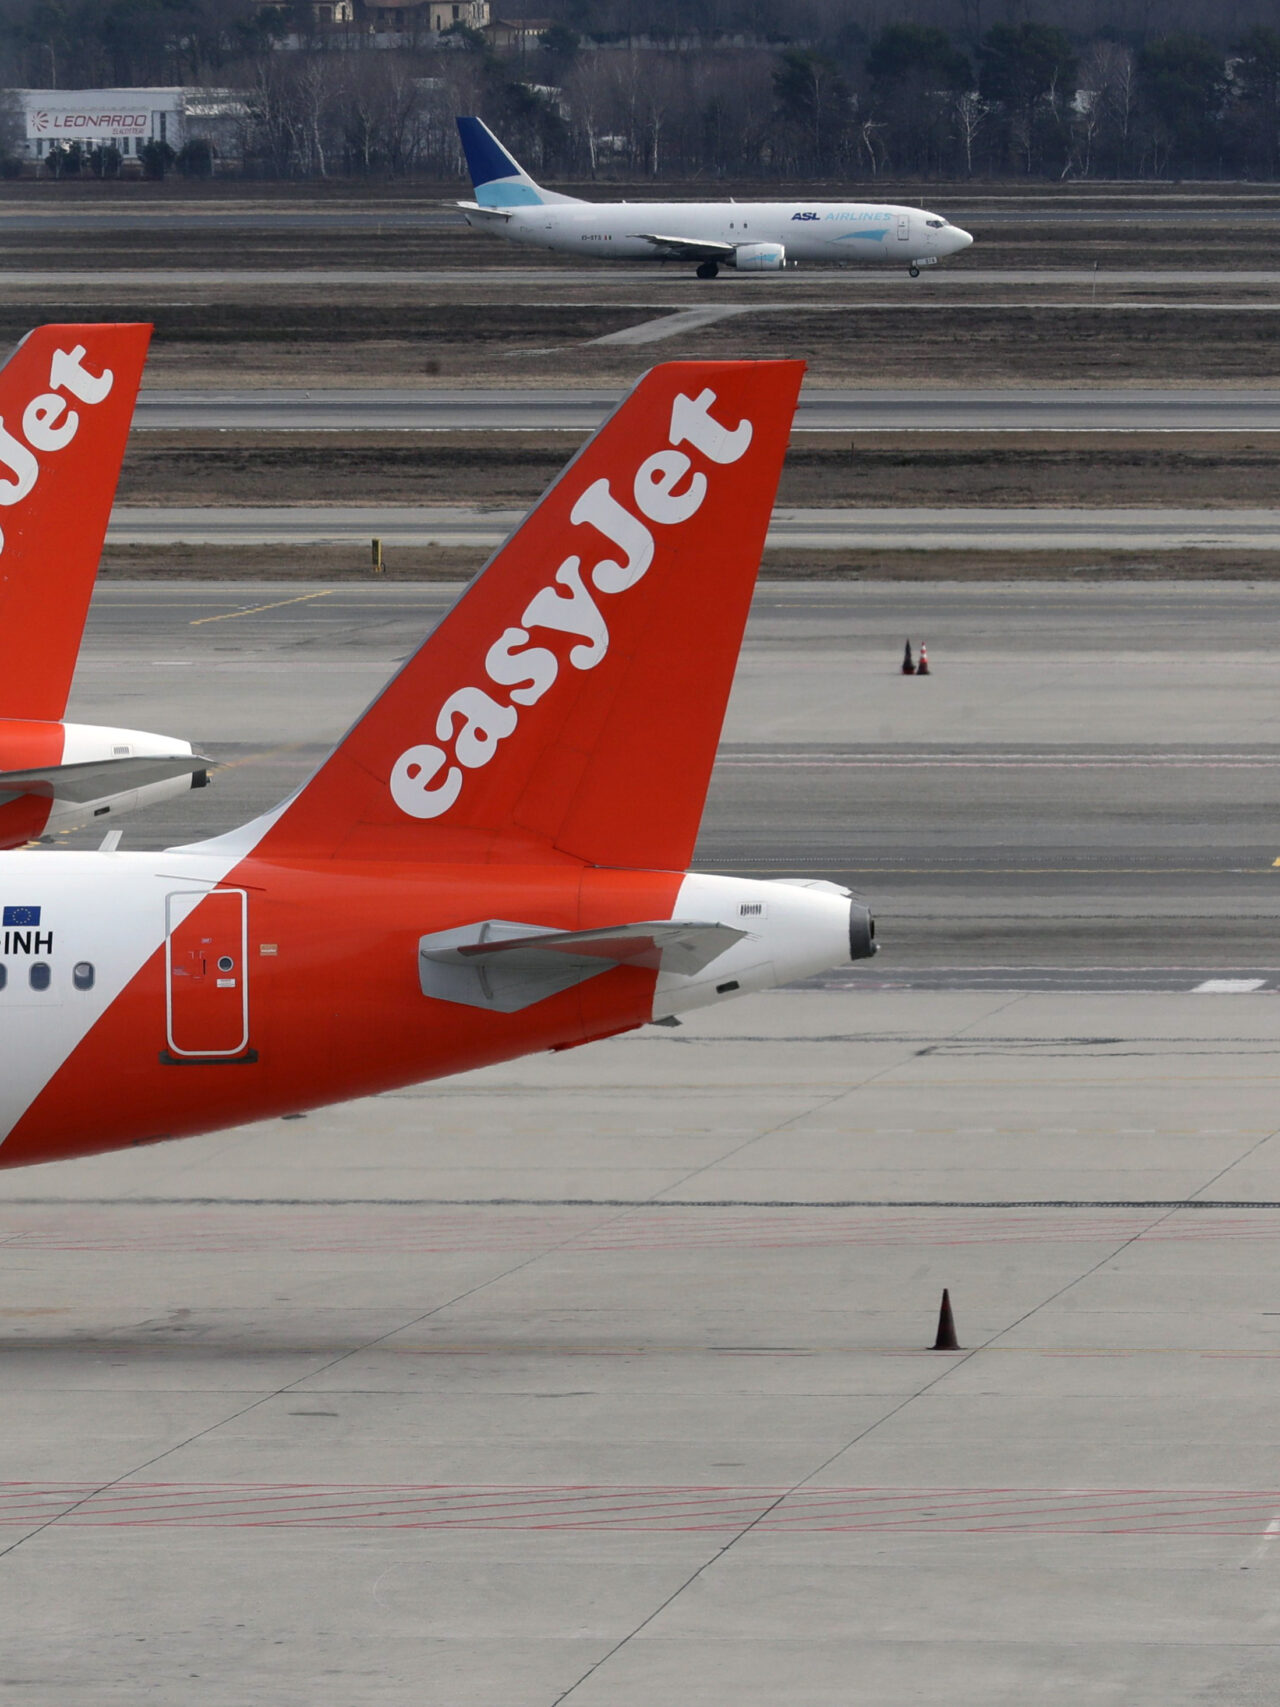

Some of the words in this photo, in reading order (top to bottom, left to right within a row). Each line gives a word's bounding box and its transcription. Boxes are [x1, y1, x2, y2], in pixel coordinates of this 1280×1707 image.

[53, 114, 147, 128] LEONARDO
[791, 212, 821, 221] ASL
[824, 212, 893, 221] AIRLINES
[390, 387, 753, 819] easyJet
